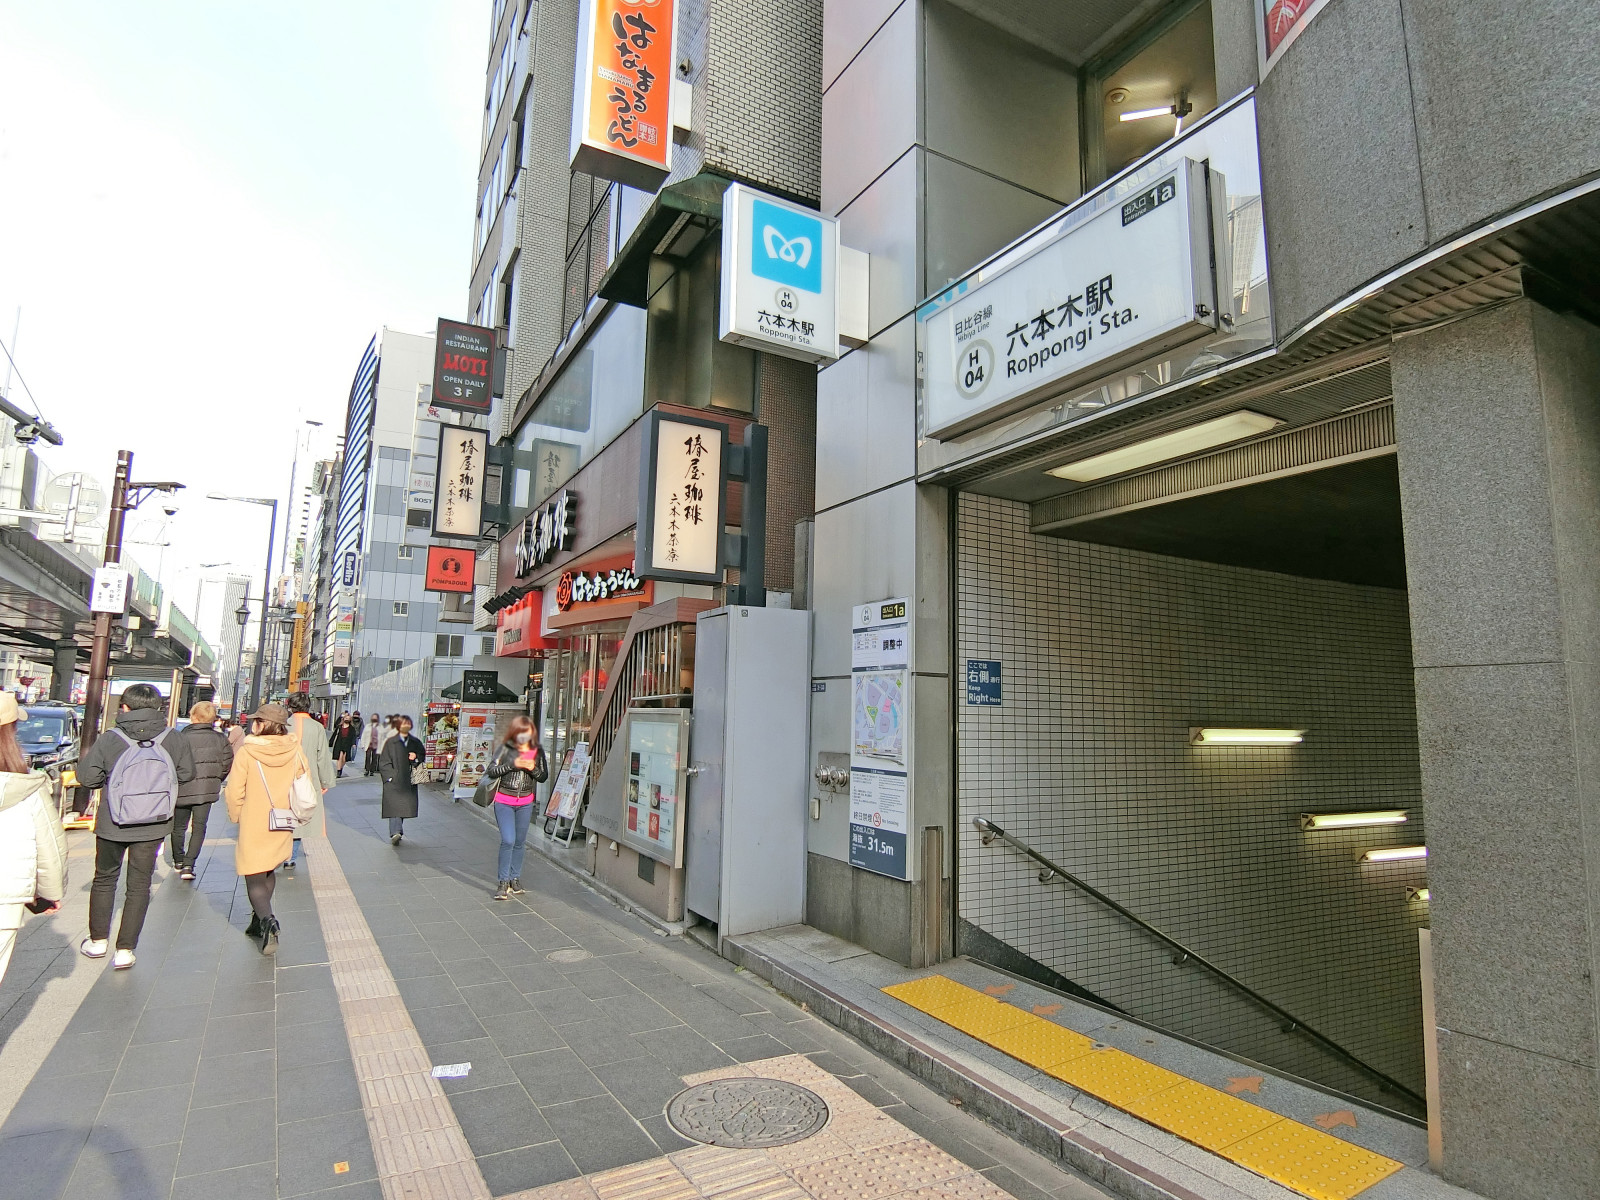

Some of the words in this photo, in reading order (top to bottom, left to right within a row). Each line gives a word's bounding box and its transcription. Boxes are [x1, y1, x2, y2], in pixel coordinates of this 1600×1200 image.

[1124, 197, 1146, 216] 出入口
[1150, 185, 1173, 206] 1a
[1125, 208, 1147, 223] Entrance
[781, 300, 792, 309] 04
[783, 292, 790, 300] H
[758, 310, 814, 337] 六本木駅
[955, 305, 993, 336] 日比谷線
[1006, 274, 1114, 356] 六本木駅
[455, 334, 480, 344] INDIAN
[760, 325, 796, 341] Roppongi
[799, 335, 813, 345] Sta.
[957, 330, 976, 343] Hibiya
[977, 321, 990, 333] Line
[1007, 321, 1093, 378] Roppongi
[1100, 308, 1139, 335] Sta.
[445, 340, 489, 353] RESTAURANT
[443, 353, 489, 377] MOTI
[969, 350, 979, 367] H
[443, 376, 463, 385] OPEN
[464, 379, 486, 388] DAILY
[965, 366, 984, 388] 04
[459, 439, 478, 502] 椿屋珈琲
[684, 434, 708, 525] 椿屋珈琲
[665, 493, 681, 562] 六本木茶寮
[344, 555, 356, 583] Berlitz
[572, 568, 640, 602] はなまるうどん
[894, 605, 904, 616] 1a
[969, 670, 989, 683] 右側
[969, 693, 988, 703] Right
[868, 836, 894, 856] 31.5m
